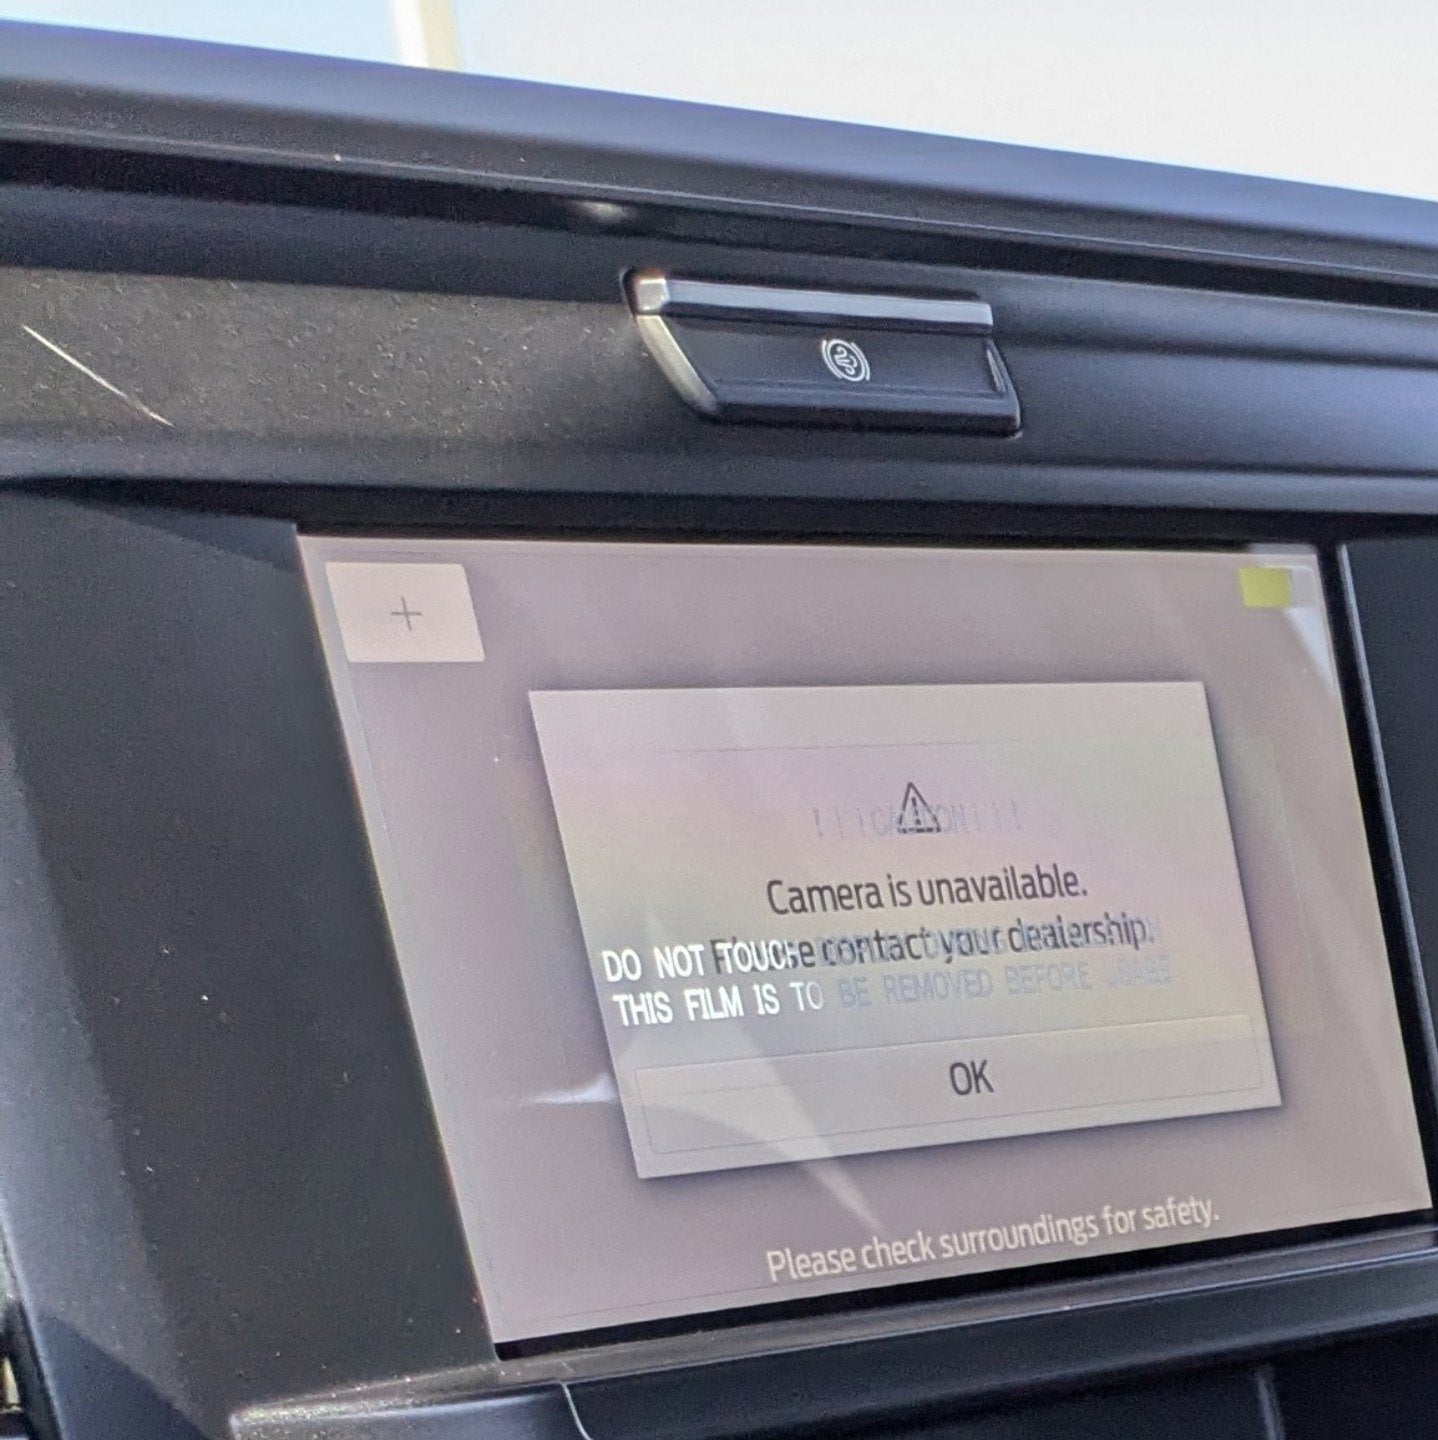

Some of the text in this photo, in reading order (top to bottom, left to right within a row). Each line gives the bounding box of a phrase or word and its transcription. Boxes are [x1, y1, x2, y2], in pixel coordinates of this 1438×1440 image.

[767, 862, 1088, 916] Camera is unavailable.
[601, 948, 642, 982] DO
[653, 943, 705, 979] NOT
[821, 927, 931, 967] contact
[934, 930, 1001, 965] your
[612, 991, 674, 1027] THIS
[684, 984, 745, 1021] FILM
[753, 983, 780, 1017] IS
[789, 980, 824, 1012] TO
[838, 976, 872, 1008] BE
[949, 1058, 994, 1096] OK
[766, 1195, 1220, 1283] Please check surroundings for safety.
